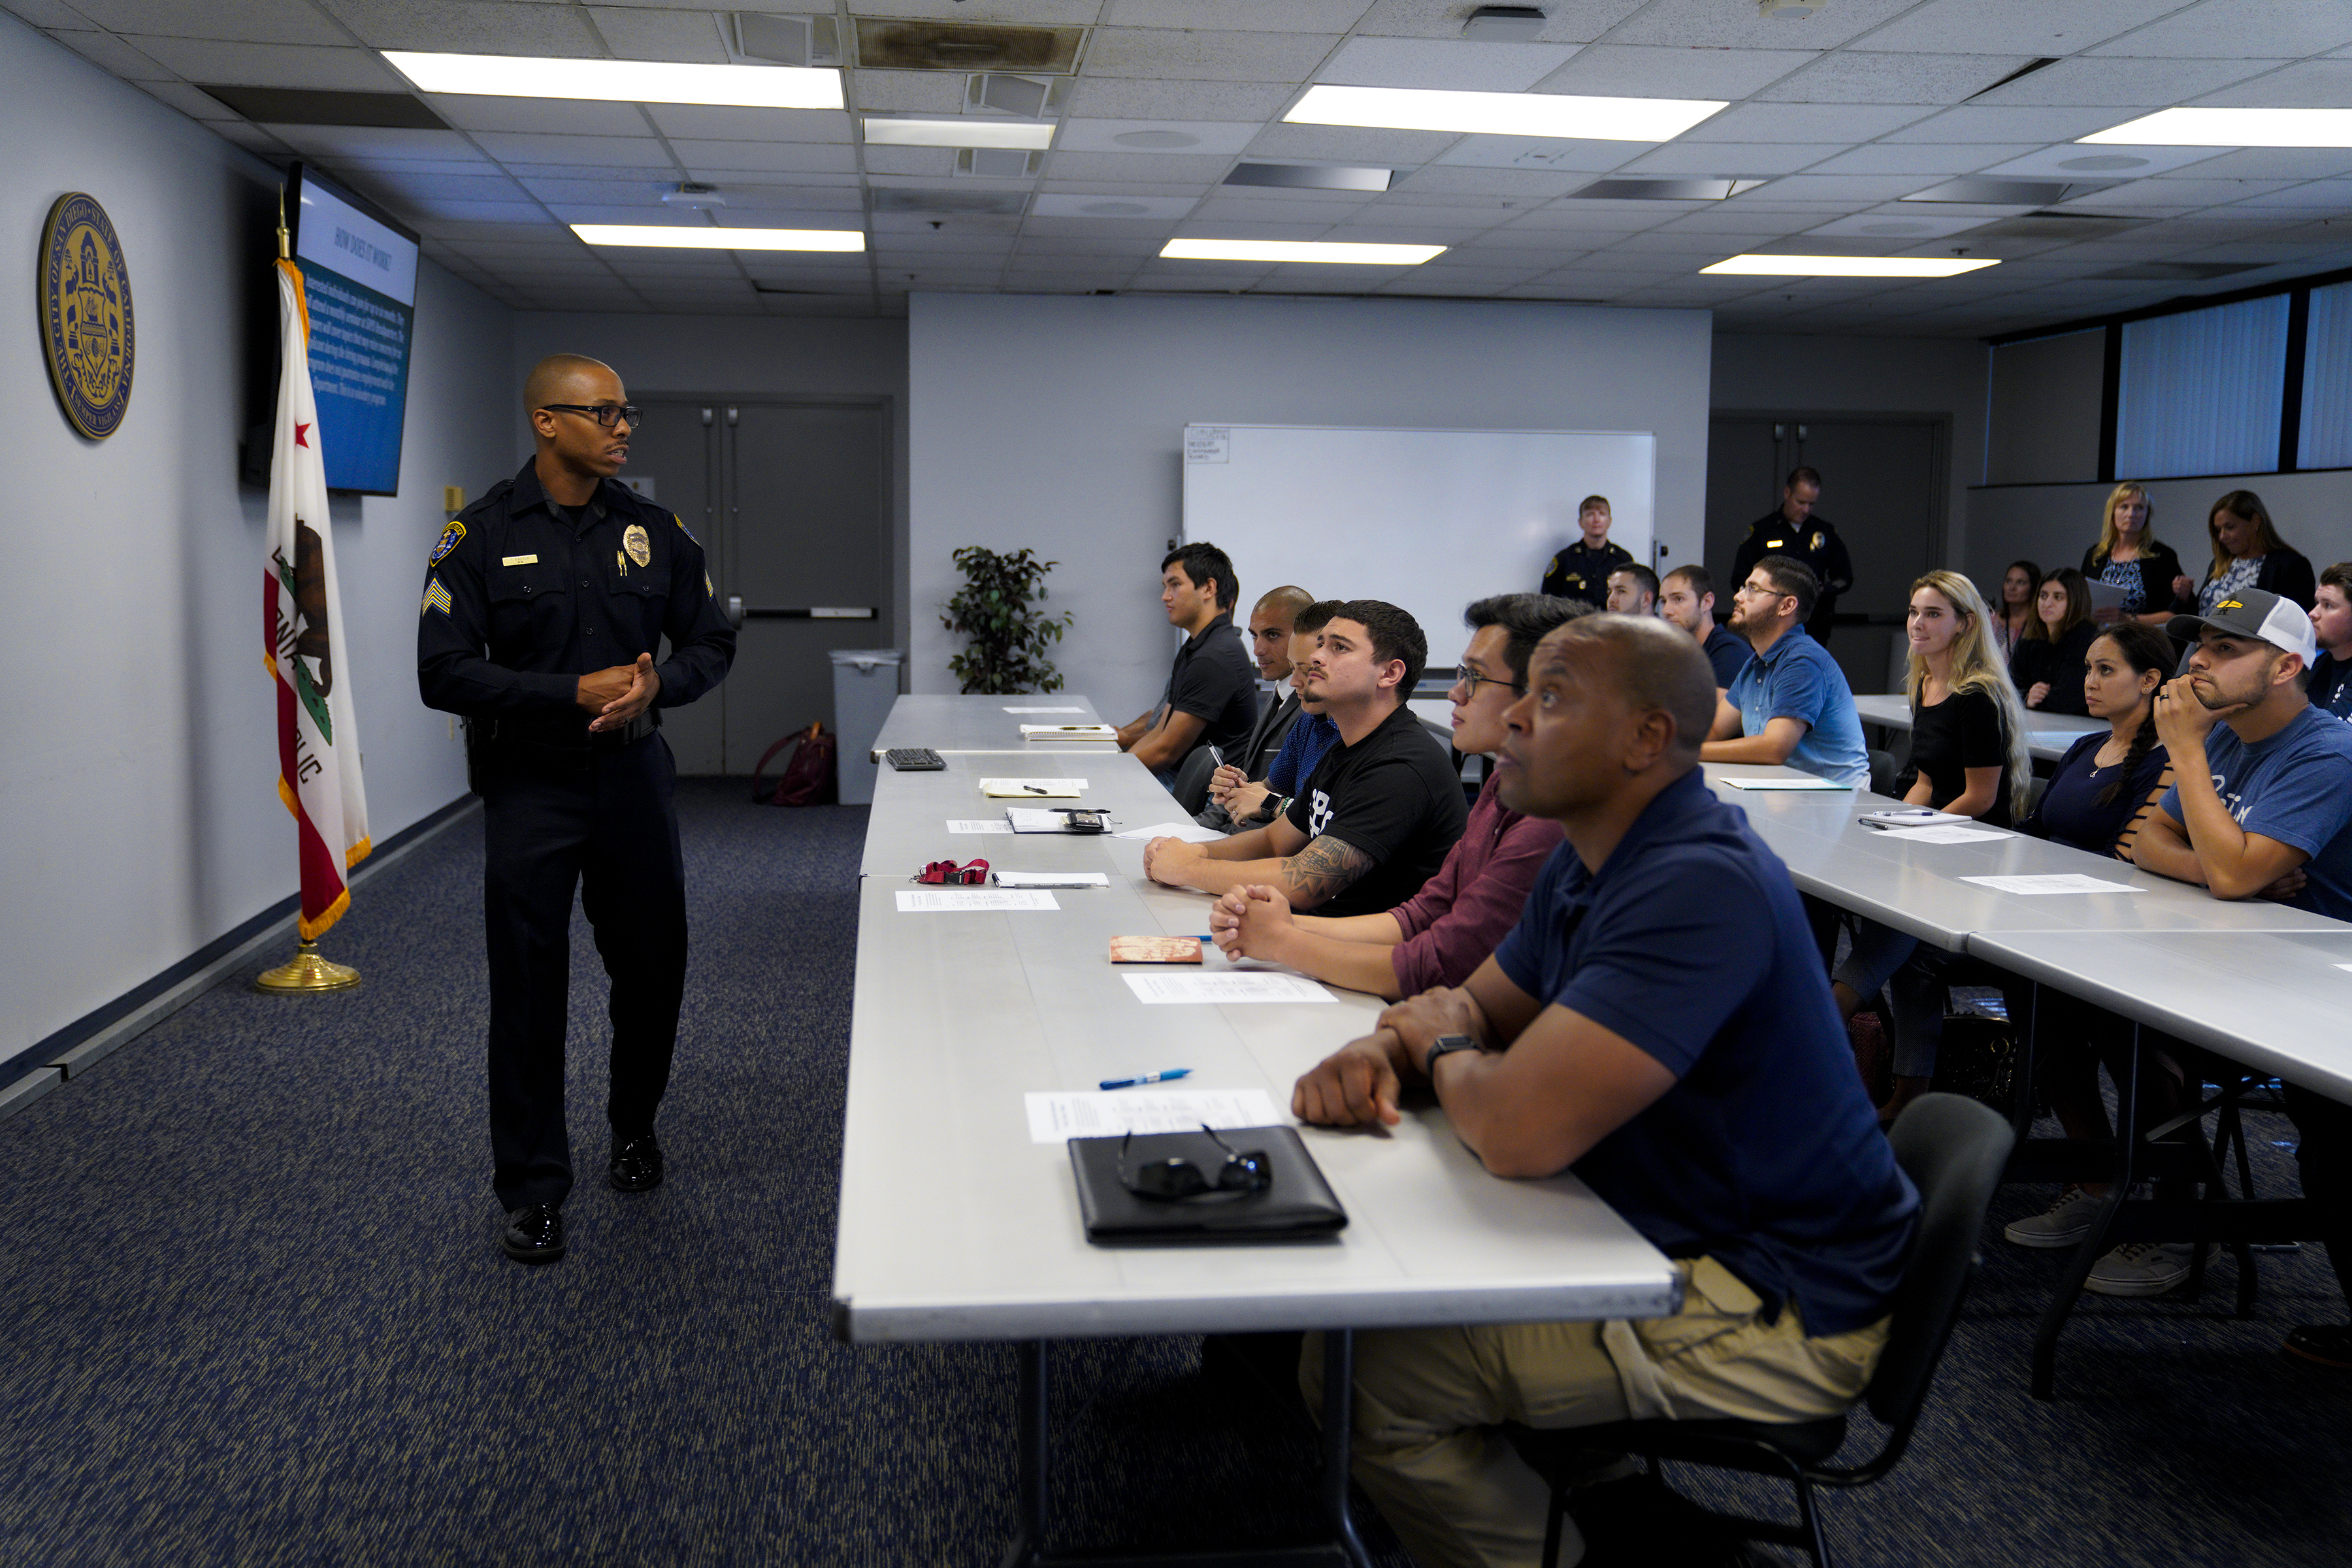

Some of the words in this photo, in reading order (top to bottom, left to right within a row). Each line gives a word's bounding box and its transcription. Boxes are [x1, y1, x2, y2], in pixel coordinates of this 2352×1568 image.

[65, 203, 88, 227] DIEGO
[91, 206, 113, 245] STATE
[55, 220, 67, 252] SAN
[335, 226, 351, 251] HOW
[350, 235, 366, 259] DOES
[365, 242, 373, 263] IT
[51, 255, 61, 284] OF
[113, 250, 124, 272] OF
[51, 289, 61, 338] CITY
[121, 280, 132, 386] CALIFORNIA
[56, 342, 71, 380] THE
[74, 395, 97, 424] SEMPER
